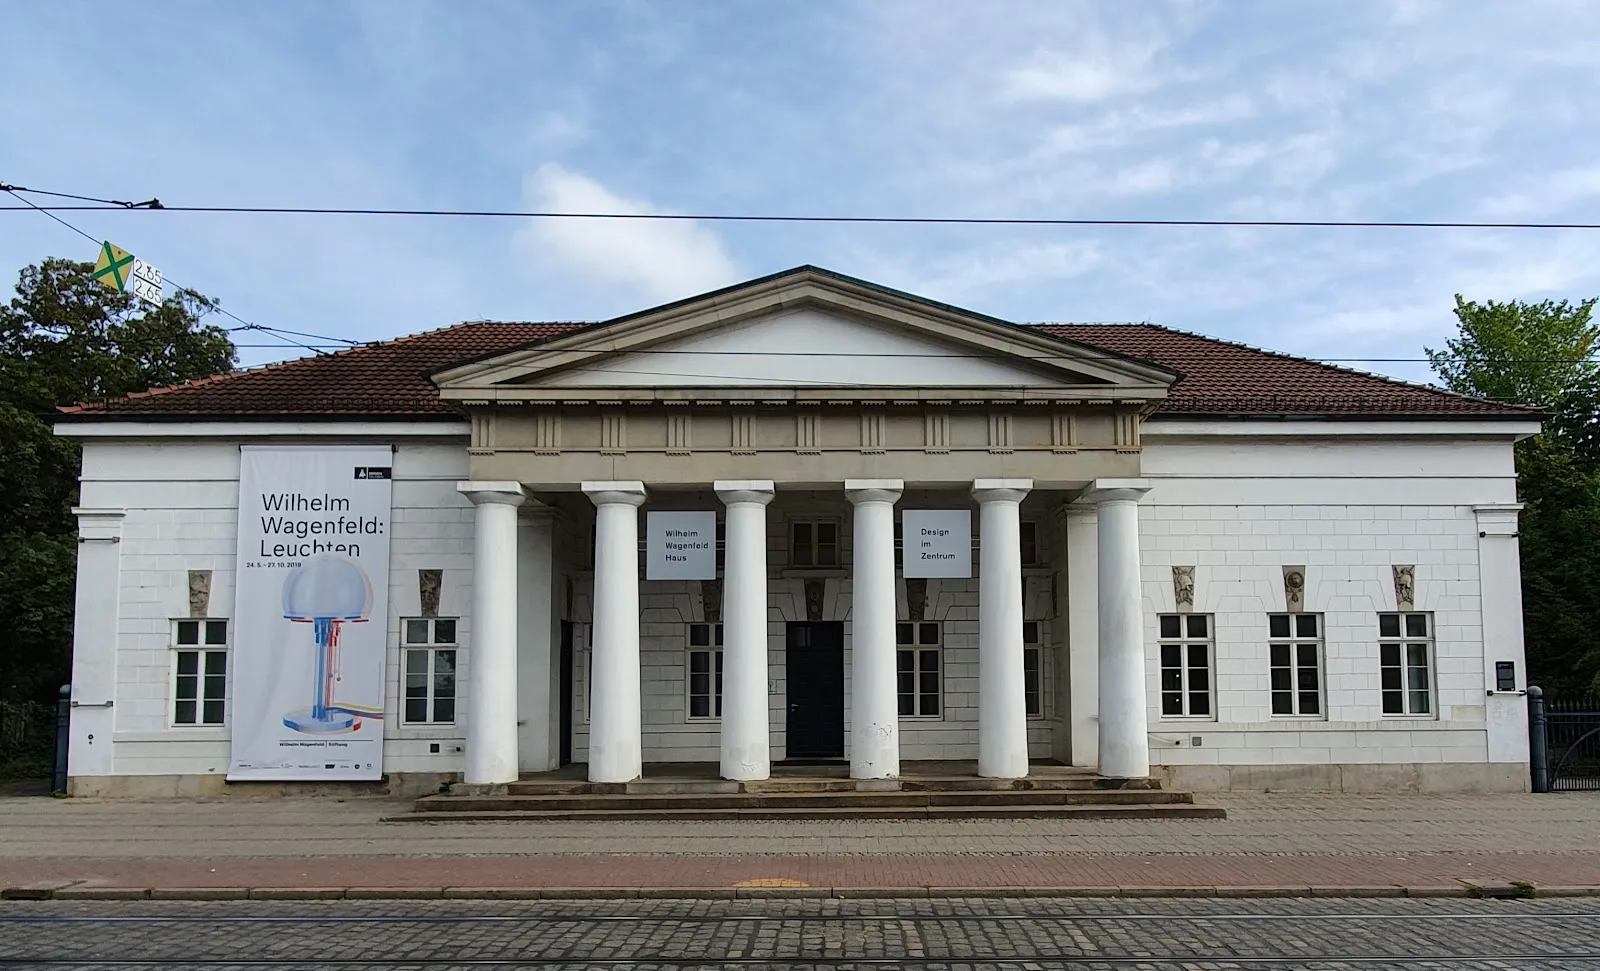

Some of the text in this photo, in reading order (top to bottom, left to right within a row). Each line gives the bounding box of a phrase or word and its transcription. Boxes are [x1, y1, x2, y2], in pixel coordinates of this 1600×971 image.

[261, 493, 350, 511] Wilhelm
[261, 516, 384, 539] Wagenfeld:
[921, 528, 949, 536] Design
[260, 539, 360, 557] Leuchten
[665, 542, 709, 550] Wagenfeld
[921, 540, 931, 548] im
[665, 554, 687, 562] Haus
[921, 552, 955, 560] Zentrum
